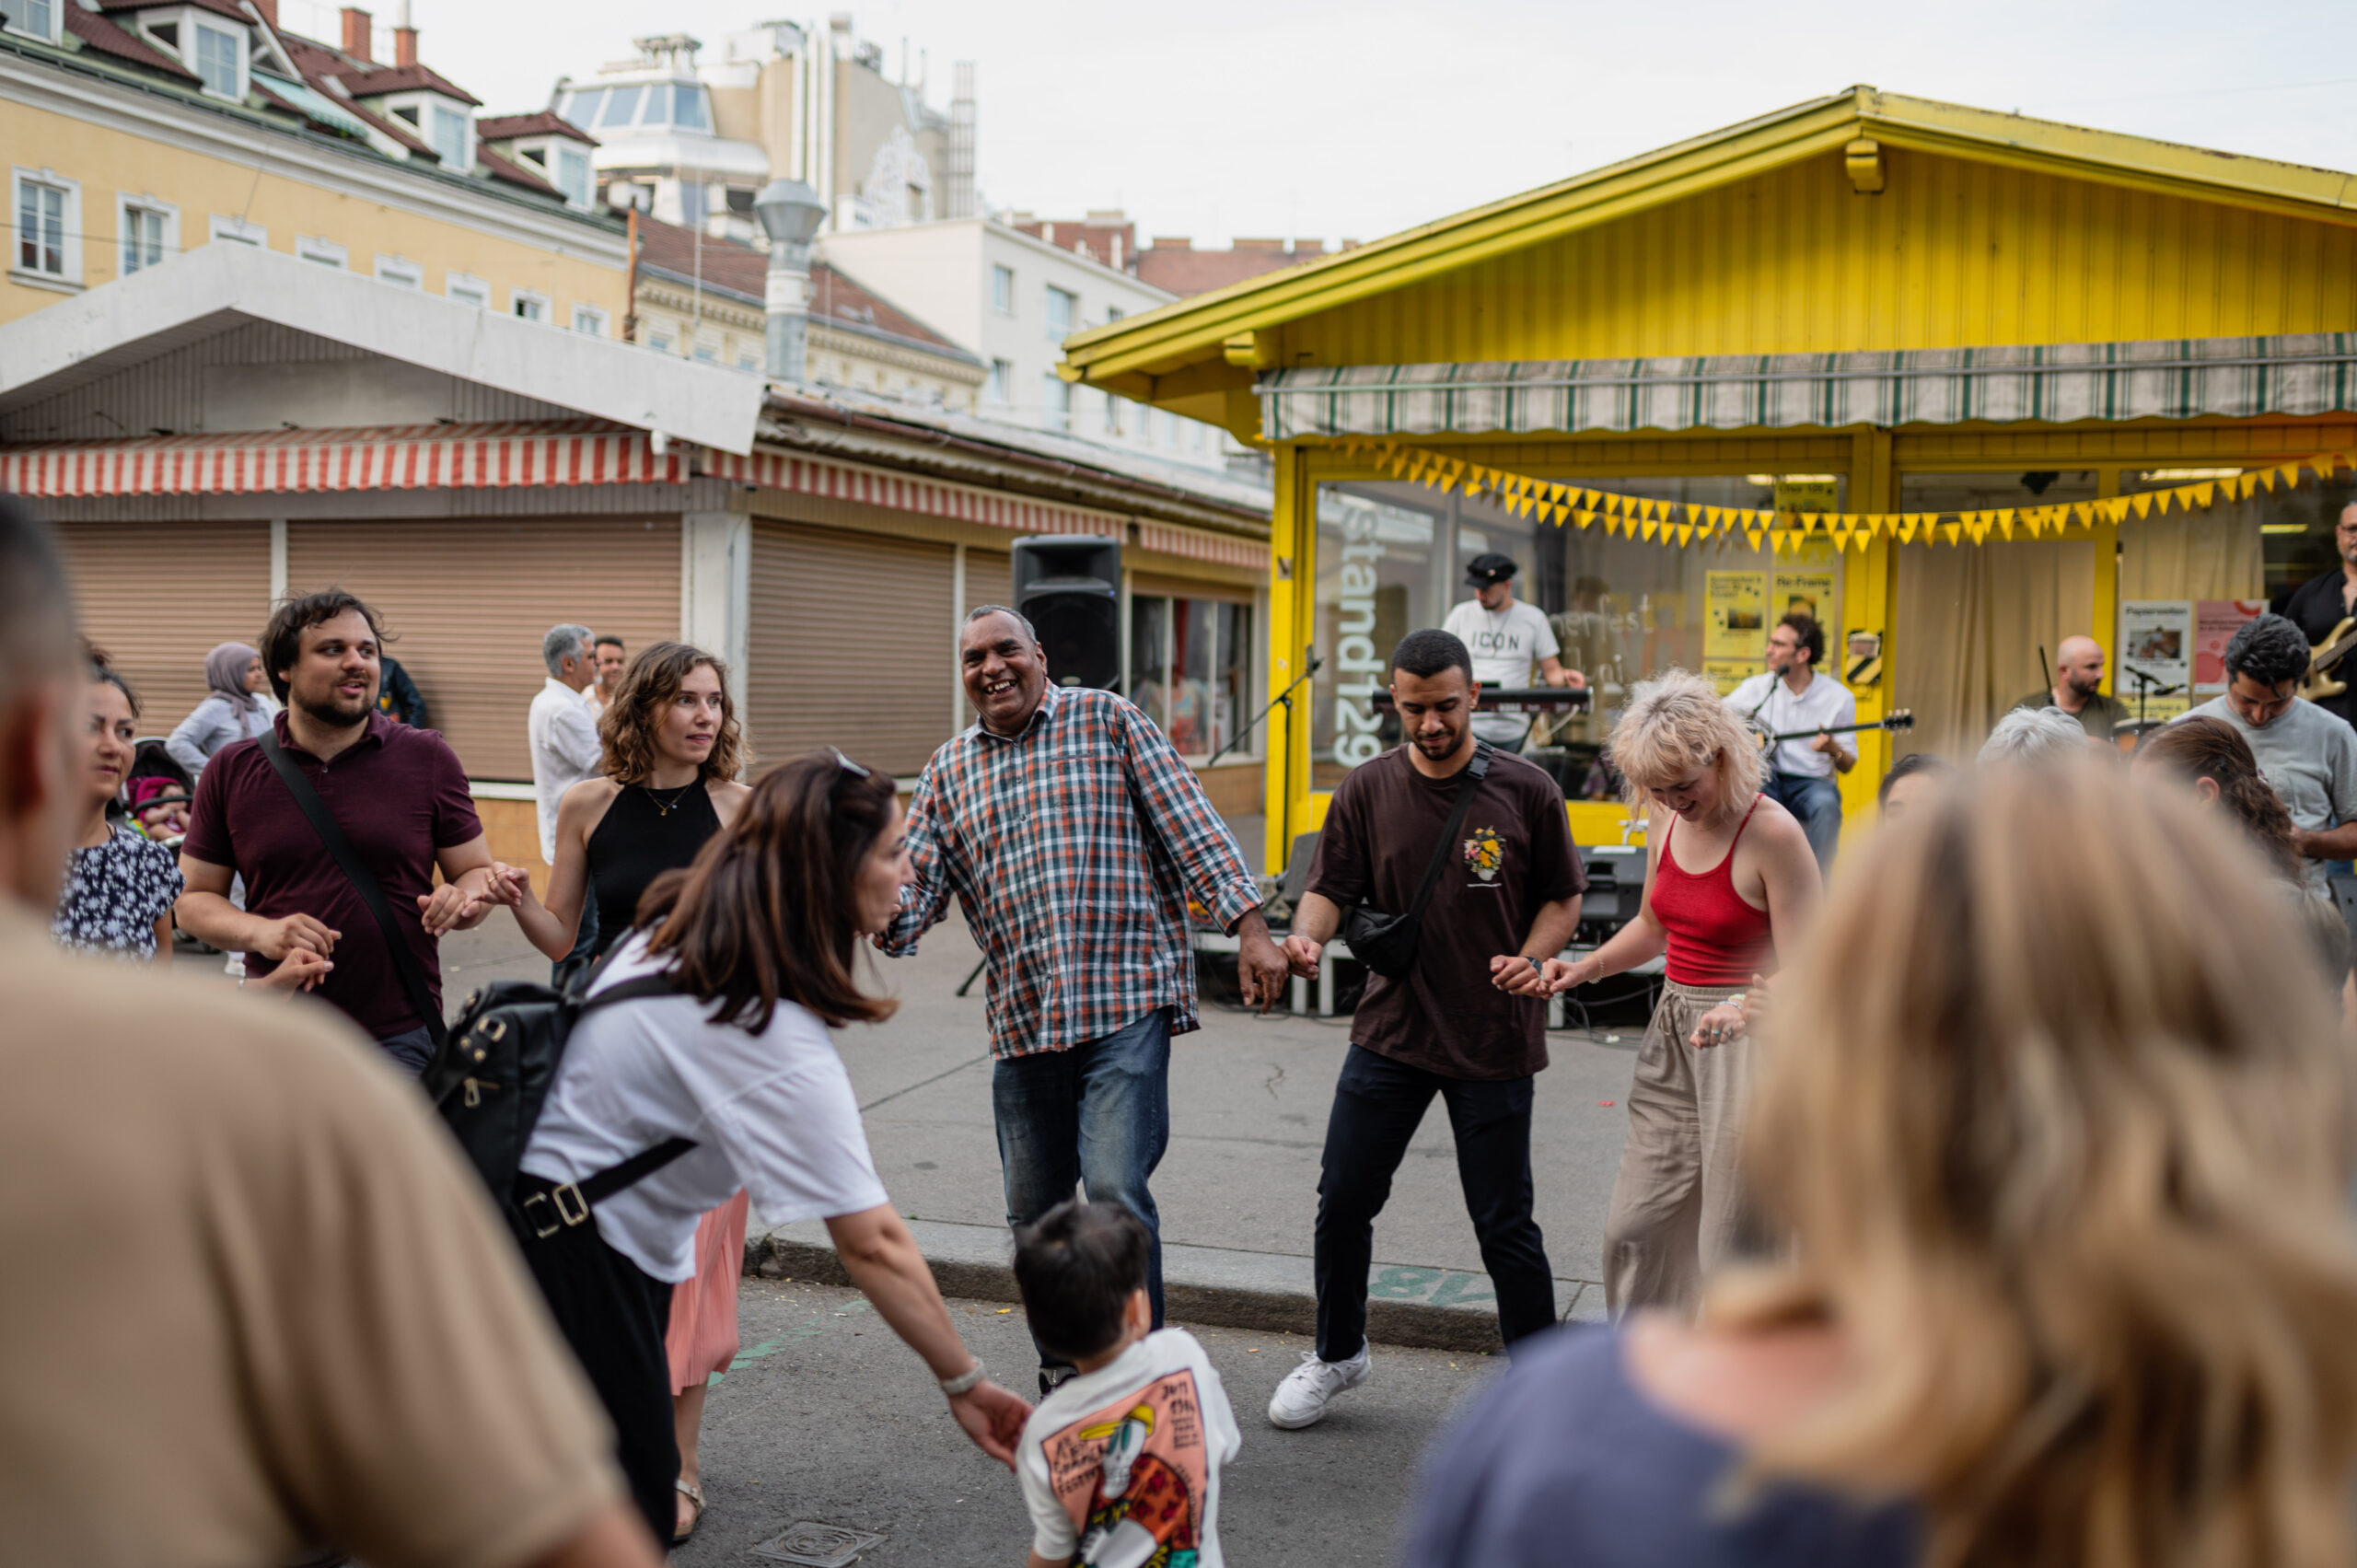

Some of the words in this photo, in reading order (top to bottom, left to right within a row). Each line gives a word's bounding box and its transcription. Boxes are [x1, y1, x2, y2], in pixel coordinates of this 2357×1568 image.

[1777, 575, 1831, 587] Re-Frame
[1333, 508, 1386, 769] stand129
[1471, 630, 1519, 651] ICON
